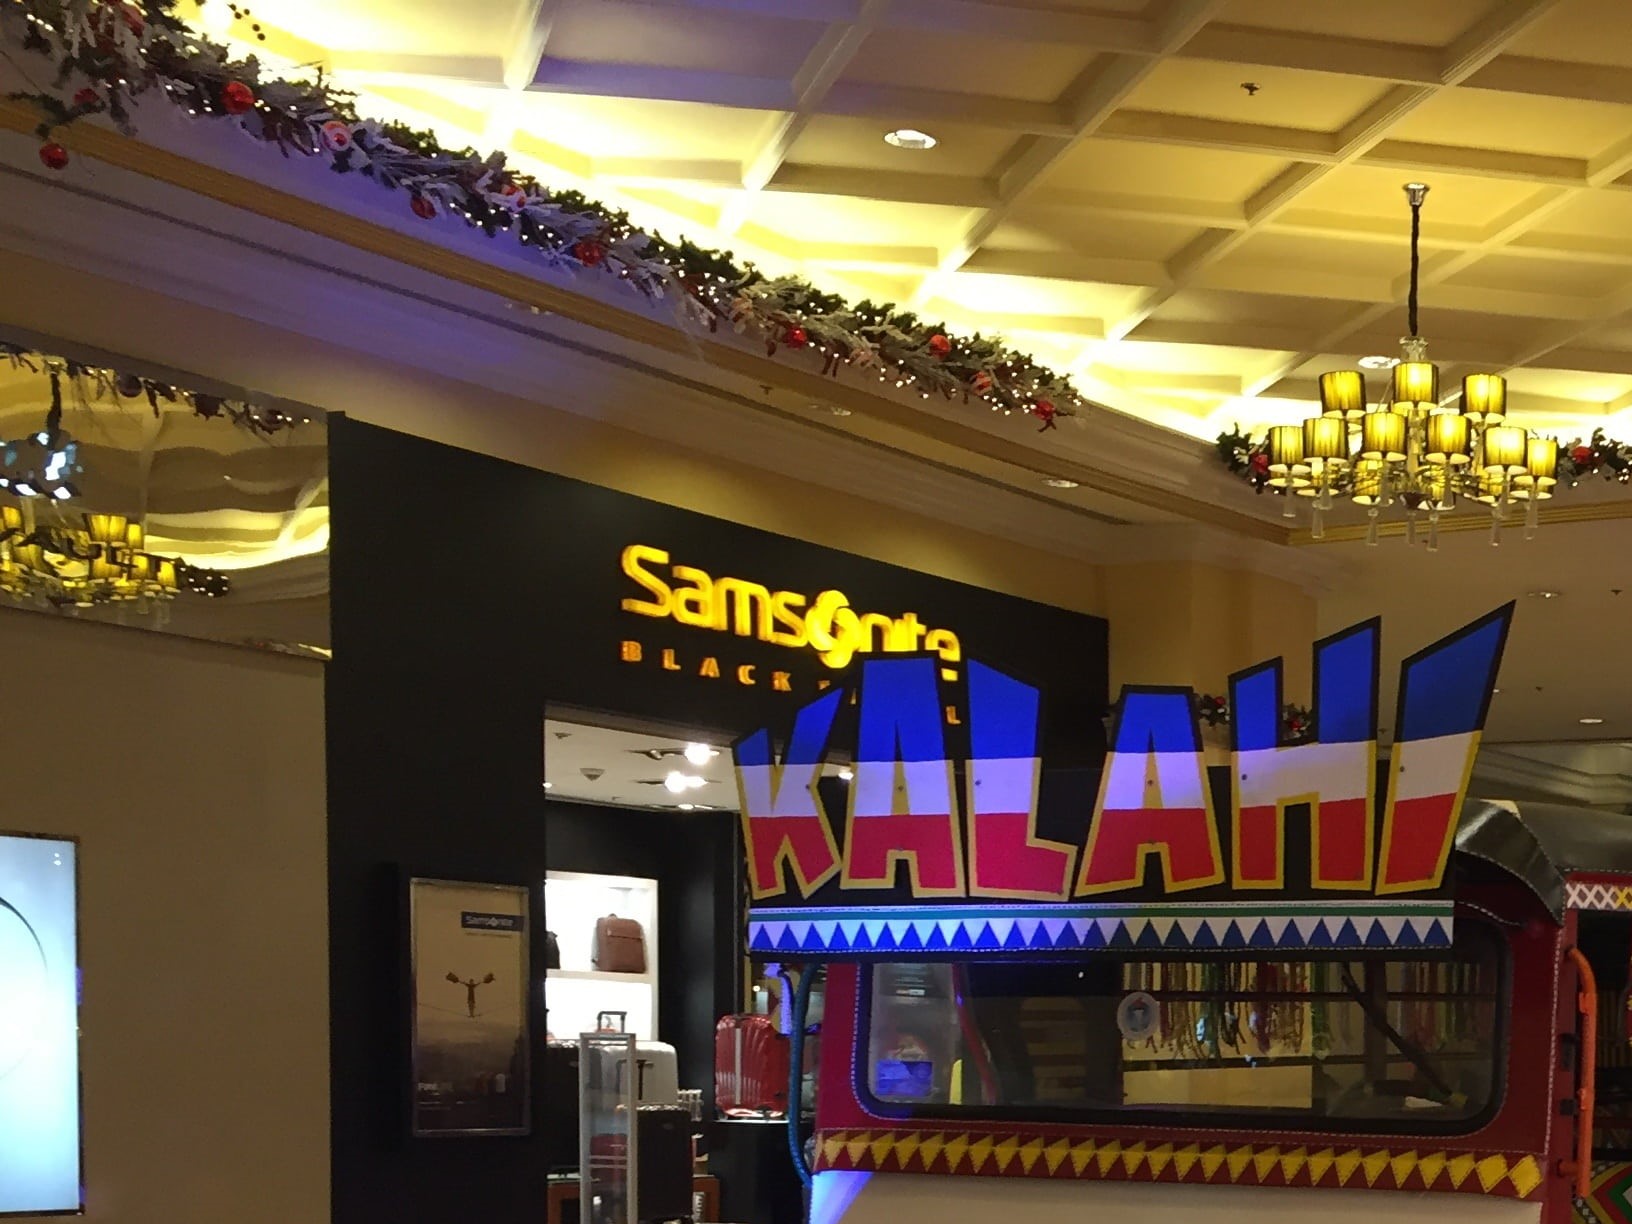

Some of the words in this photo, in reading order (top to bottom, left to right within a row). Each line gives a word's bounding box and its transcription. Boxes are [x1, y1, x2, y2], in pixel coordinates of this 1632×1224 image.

[620, 640, 793, 692] BLACK
[621, 543, 962, 682] Samsonite
[732, 600, 1517, 902] KALAHI
